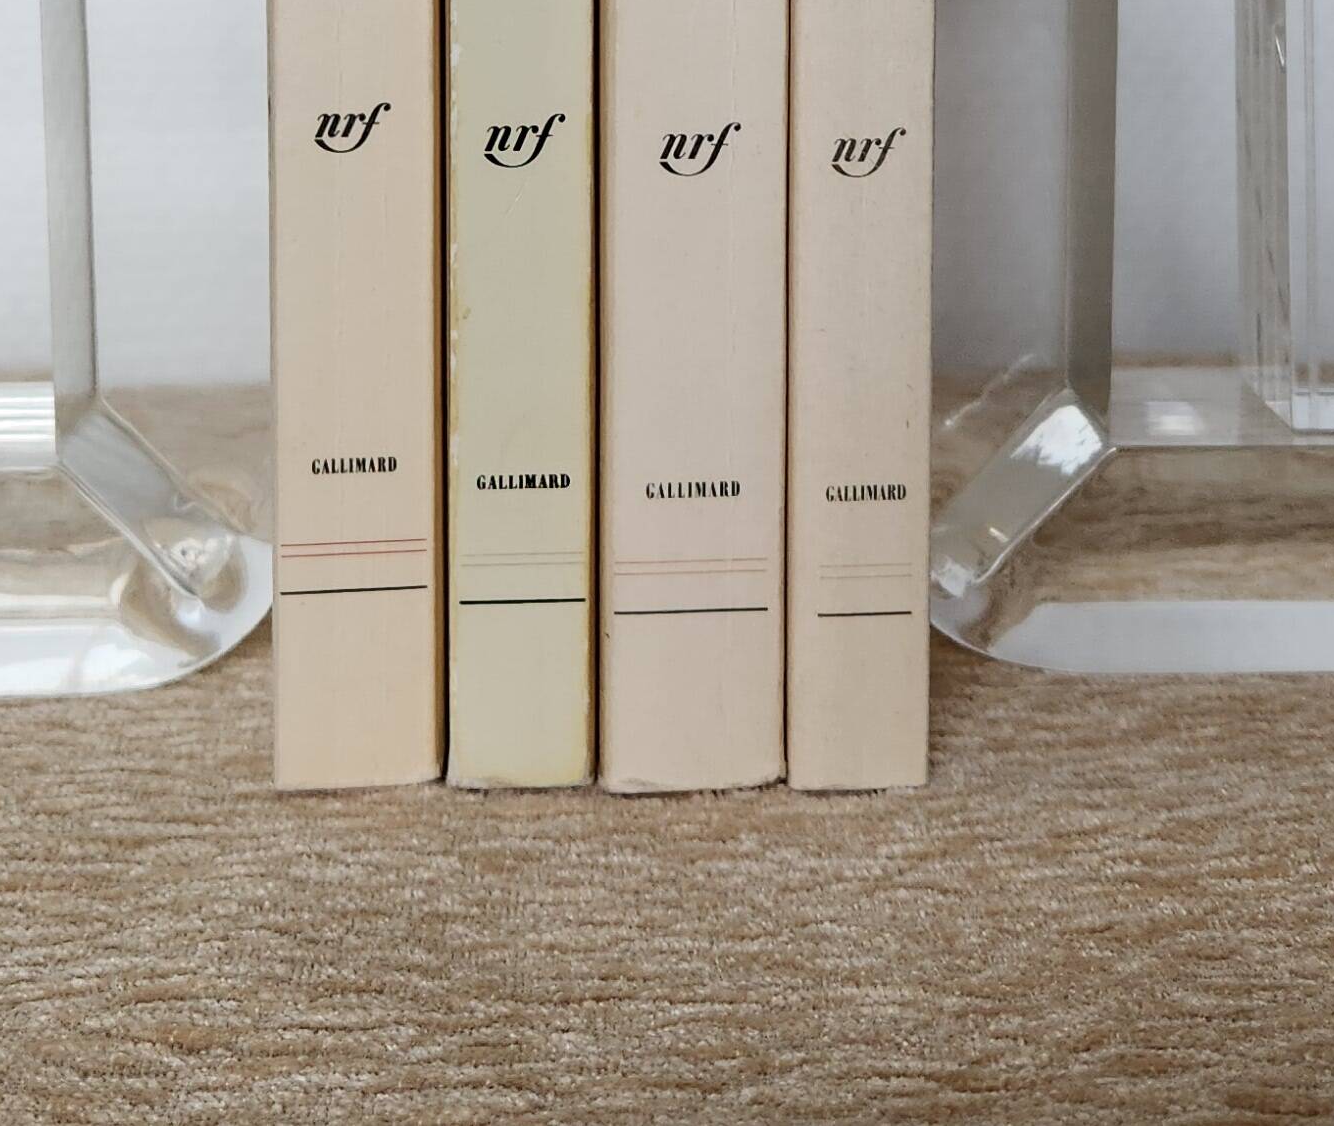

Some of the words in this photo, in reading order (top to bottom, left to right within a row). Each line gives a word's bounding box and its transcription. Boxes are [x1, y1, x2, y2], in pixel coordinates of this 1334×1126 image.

[315, 103, 391, 153] nrf
[484, 114, 565, 168] nrf
[660, 123, 741, 176] nrf
[832, 128, 906, 177] nrf
[312, 457, 397, 474] GALLIMARD
[477, 474, 570, 489] GALLIMARD
[646, 481, 740, 498] GALLIMARD
[826, 485, 906, 501] GALLIMARD
